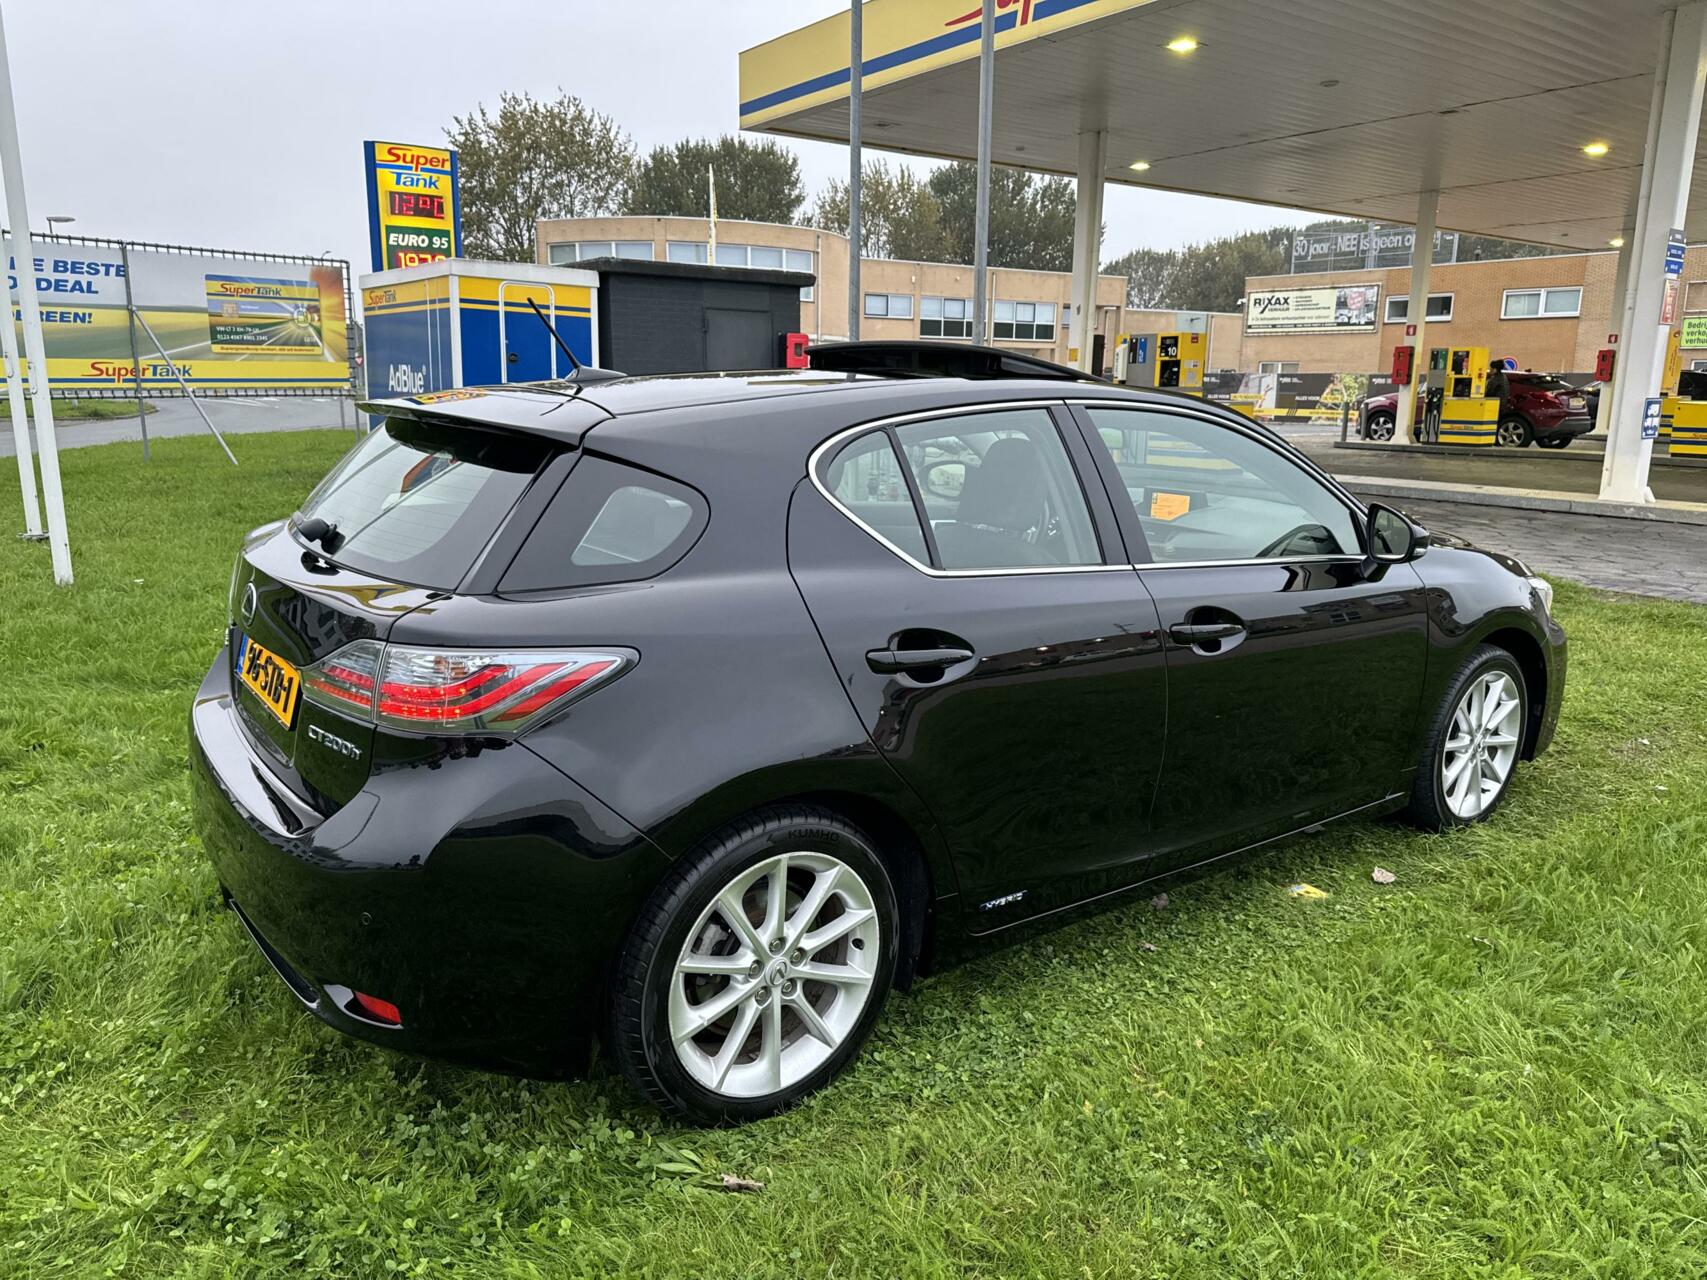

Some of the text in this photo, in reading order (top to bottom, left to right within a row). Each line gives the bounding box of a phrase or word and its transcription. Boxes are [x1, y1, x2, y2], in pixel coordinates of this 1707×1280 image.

[376, 146, 449, 172] Super
[389, 171, 440, 190] Tank
[388, 233, 449, 249] EURO 95
[1294, 240, 1308, 256] 30
[1308, 240, 1330, 261] jaar
[1337, 234, 1358, 252] NEE
[1373, 234, 1402, 255] geen
[53, 259, 126, 277] BESTE
[215, 282, 283, 297] SuperTank
[1167, 346, 1177, 356] 10
[81, 361, 192, 383] SuperTank
